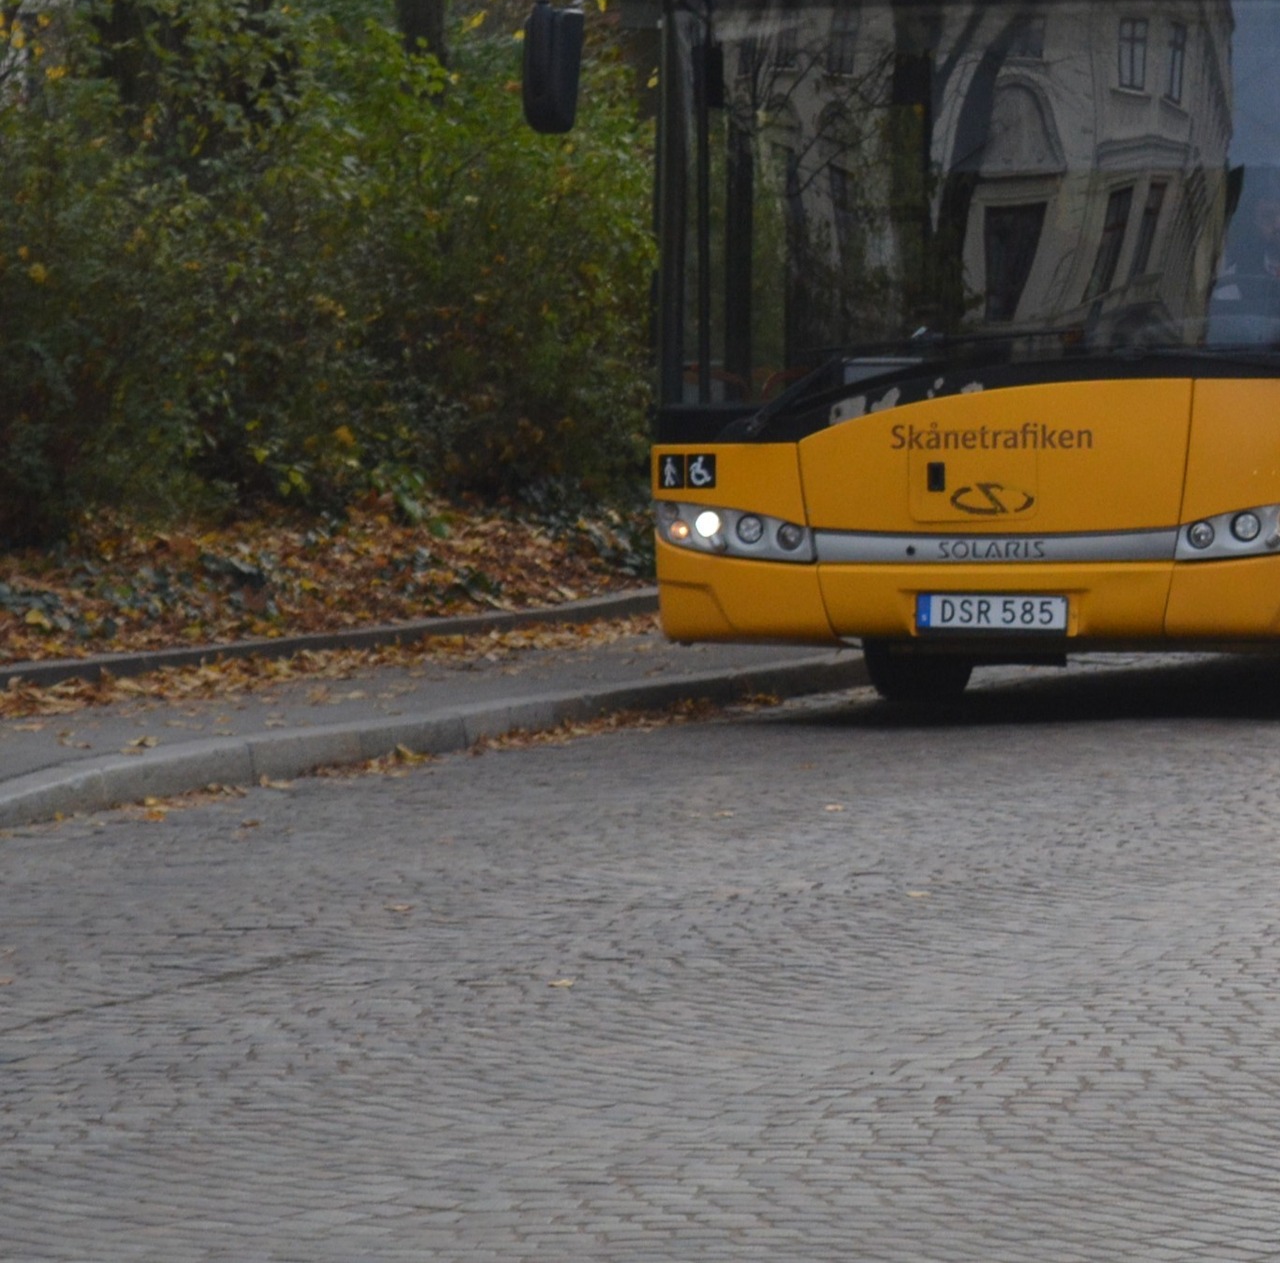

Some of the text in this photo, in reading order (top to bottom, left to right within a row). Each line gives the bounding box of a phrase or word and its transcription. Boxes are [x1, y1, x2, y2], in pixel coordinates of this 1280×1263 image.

[890, 422, 1094, 450] Skånetrafiken
[938, 540, 1045, 559] SOLARIS
[941, 598, 1054, 625] DSR 585
